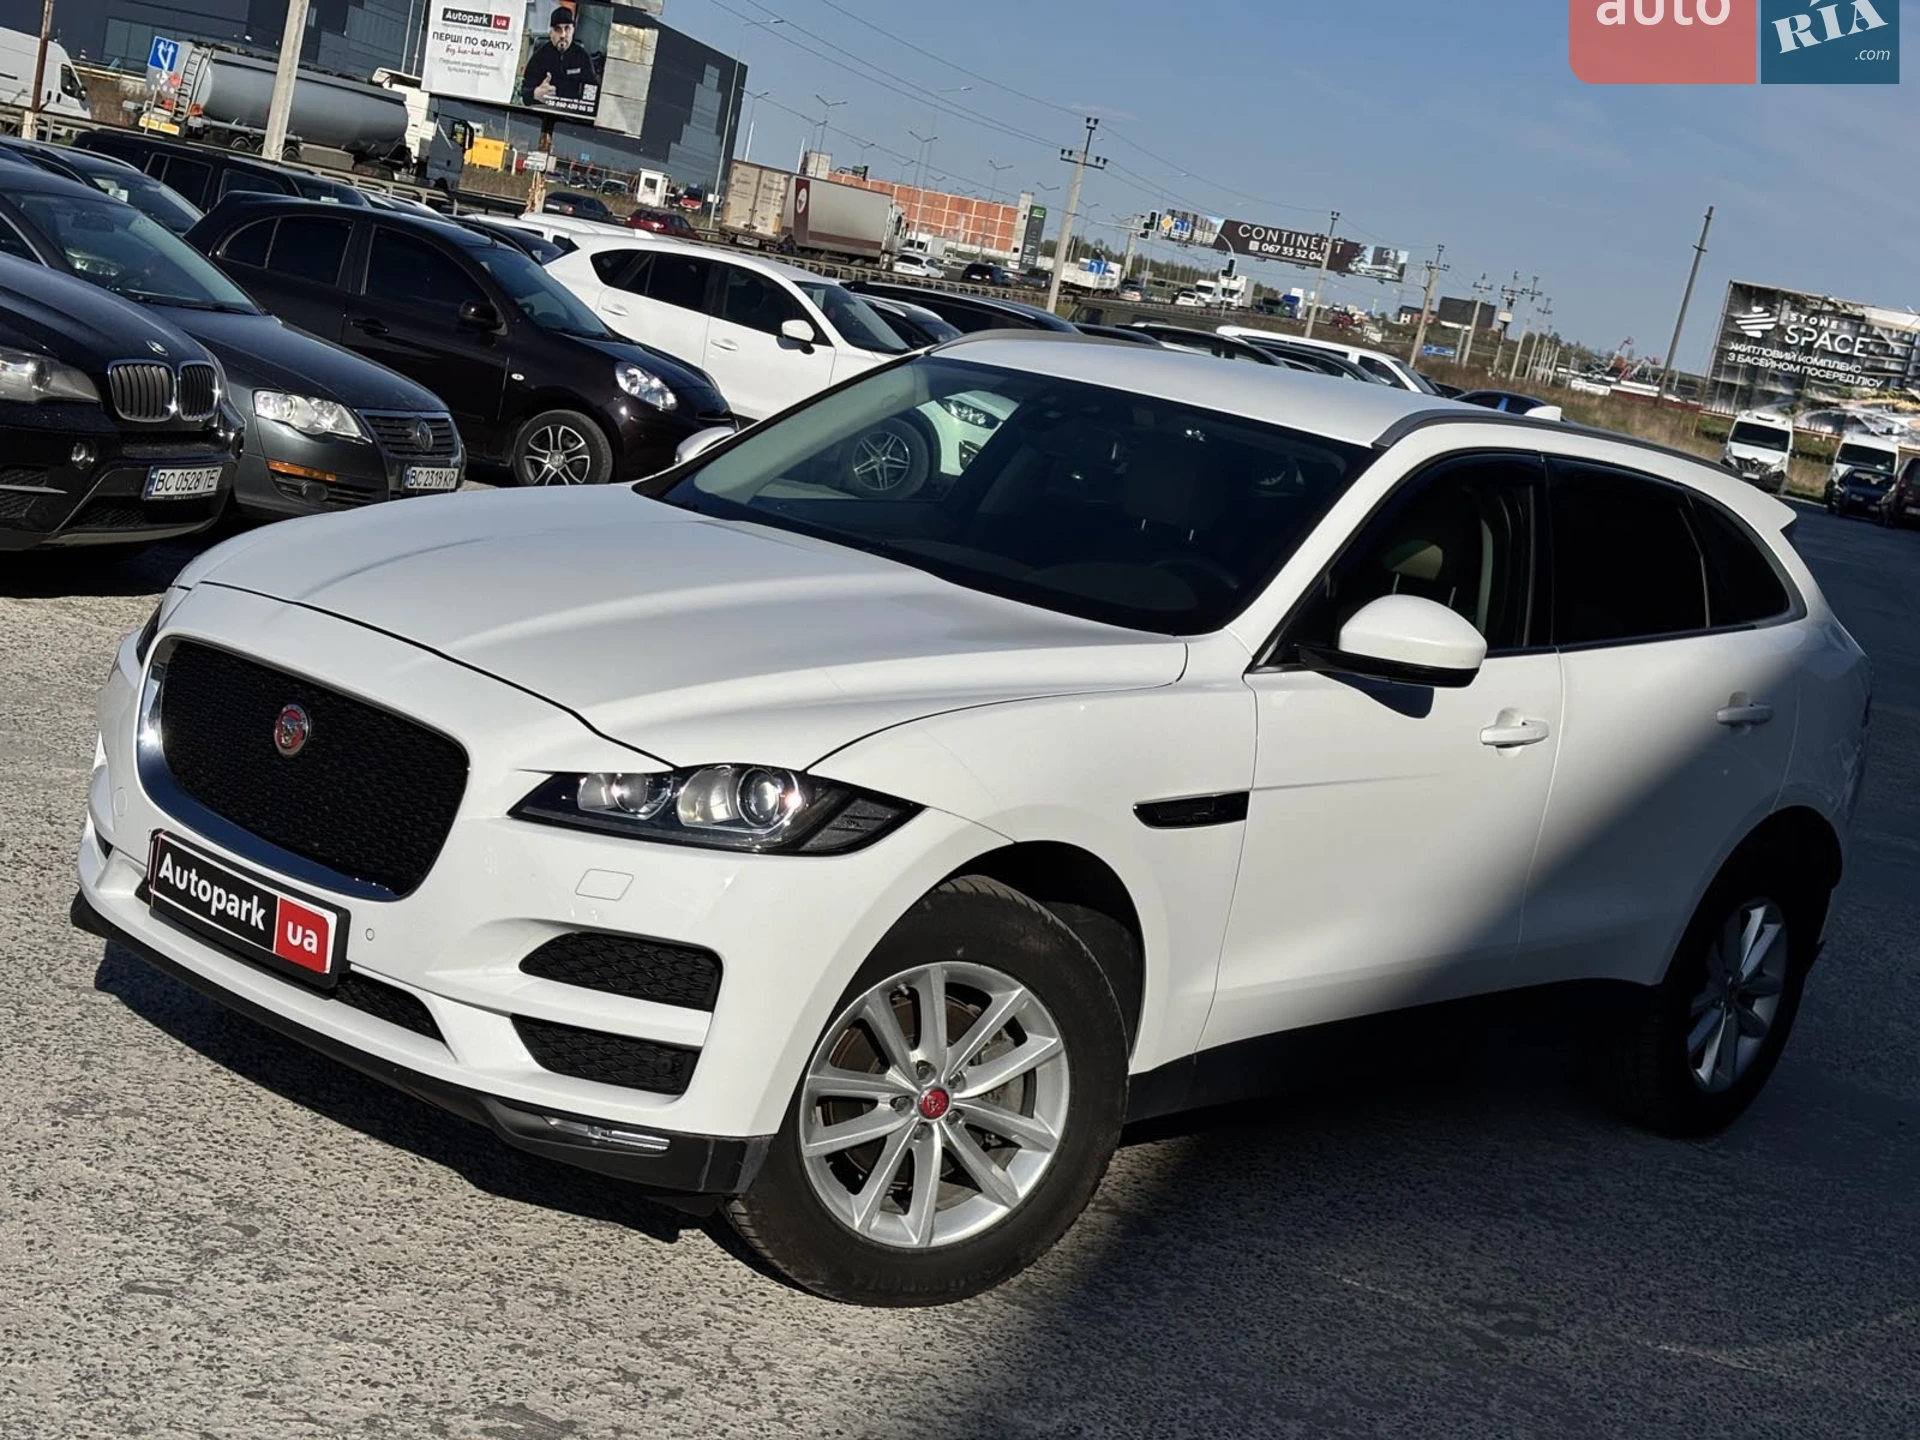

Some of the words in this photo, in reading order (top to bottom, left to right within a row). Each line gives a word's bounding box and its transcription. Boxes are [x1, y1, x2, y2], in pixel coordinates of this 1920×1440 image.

[445, 10, 488, 25] Autopark
[496, 19, 507, 27] ua
[432, 31, 462, 43] ПЕРШІ
[464, 36, 479, 46] ПО
[480, 39, 514, 51] ФАКТУ.
[1261, 242, 1281, 254] 067
[1281, 246, 1294, 257] 33
[1295, 248, 1308, 259] 32
[1309, 251, 1326, 261] 04
[1789, 312, 1838, 330] STONE
[1784, 324, 1872, 357] SPACE
[1728, 341, 1797, 361] ЖИТЛОВИЙ
[1798, 354, 1862, 374] КОМПЛЕКС
[1736, 354, 1800, 373] БАСЕЙНОМ
[1801, 365, 1855, 384] ПОСЕРЕД
[1855, 375, 1884, 388] ЛІСУ
[154, 472, 175, 491] BC
[175, 471, 202, 491] 0528
[202, 469, 218, 489] TE
[409, 470, 424, 486] BC
[158, 852, 266, 931] Autopark
[286, 921, 318, 954] ua
